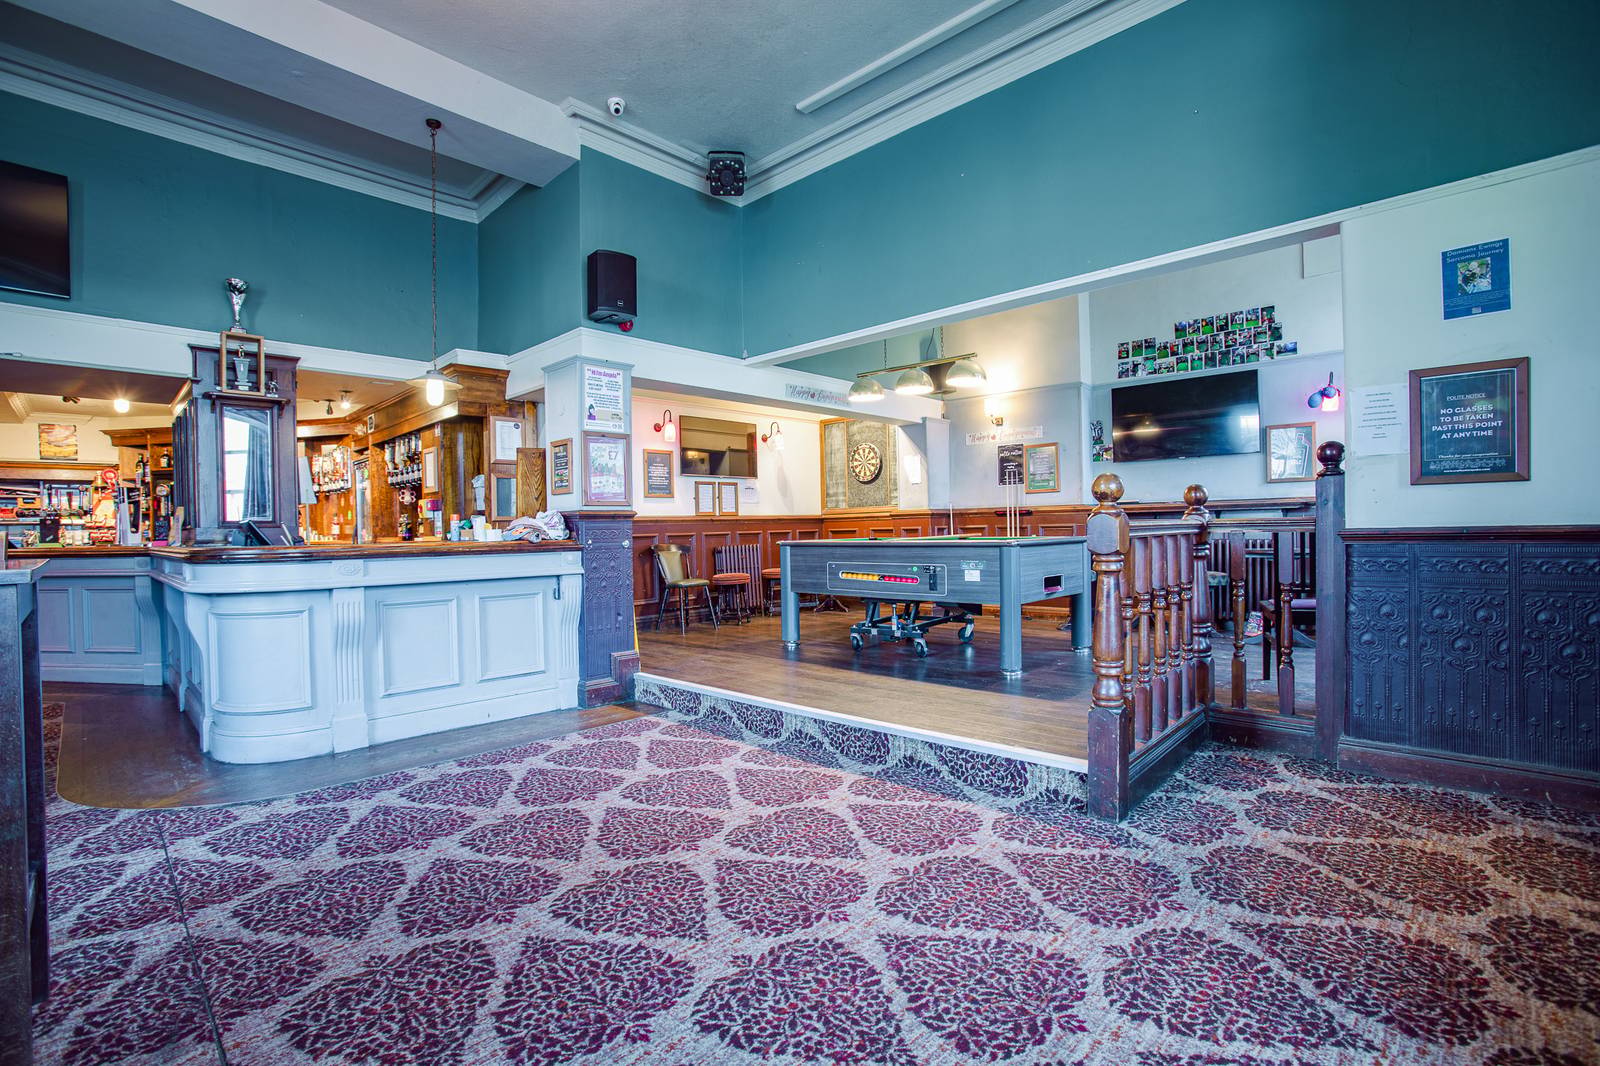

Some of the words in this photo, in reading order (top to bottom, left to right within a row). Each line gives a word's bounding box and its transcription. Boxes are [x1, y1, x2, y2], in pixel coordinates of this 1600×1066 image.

[1477, 248, 1504, 258] Journey
[1465, 392, 1487, 400] NOTICE
[1454, 404, 1494, 413] GLASSES
[1465, 412, 1494, 421] TAKEN
[1432, 424, 1453, 432] PAST
[1454, 422, 1474, 430] THIS
[1475, 420, 1503, 428] POINT
[1471, 429, 1493, 437] TIME
